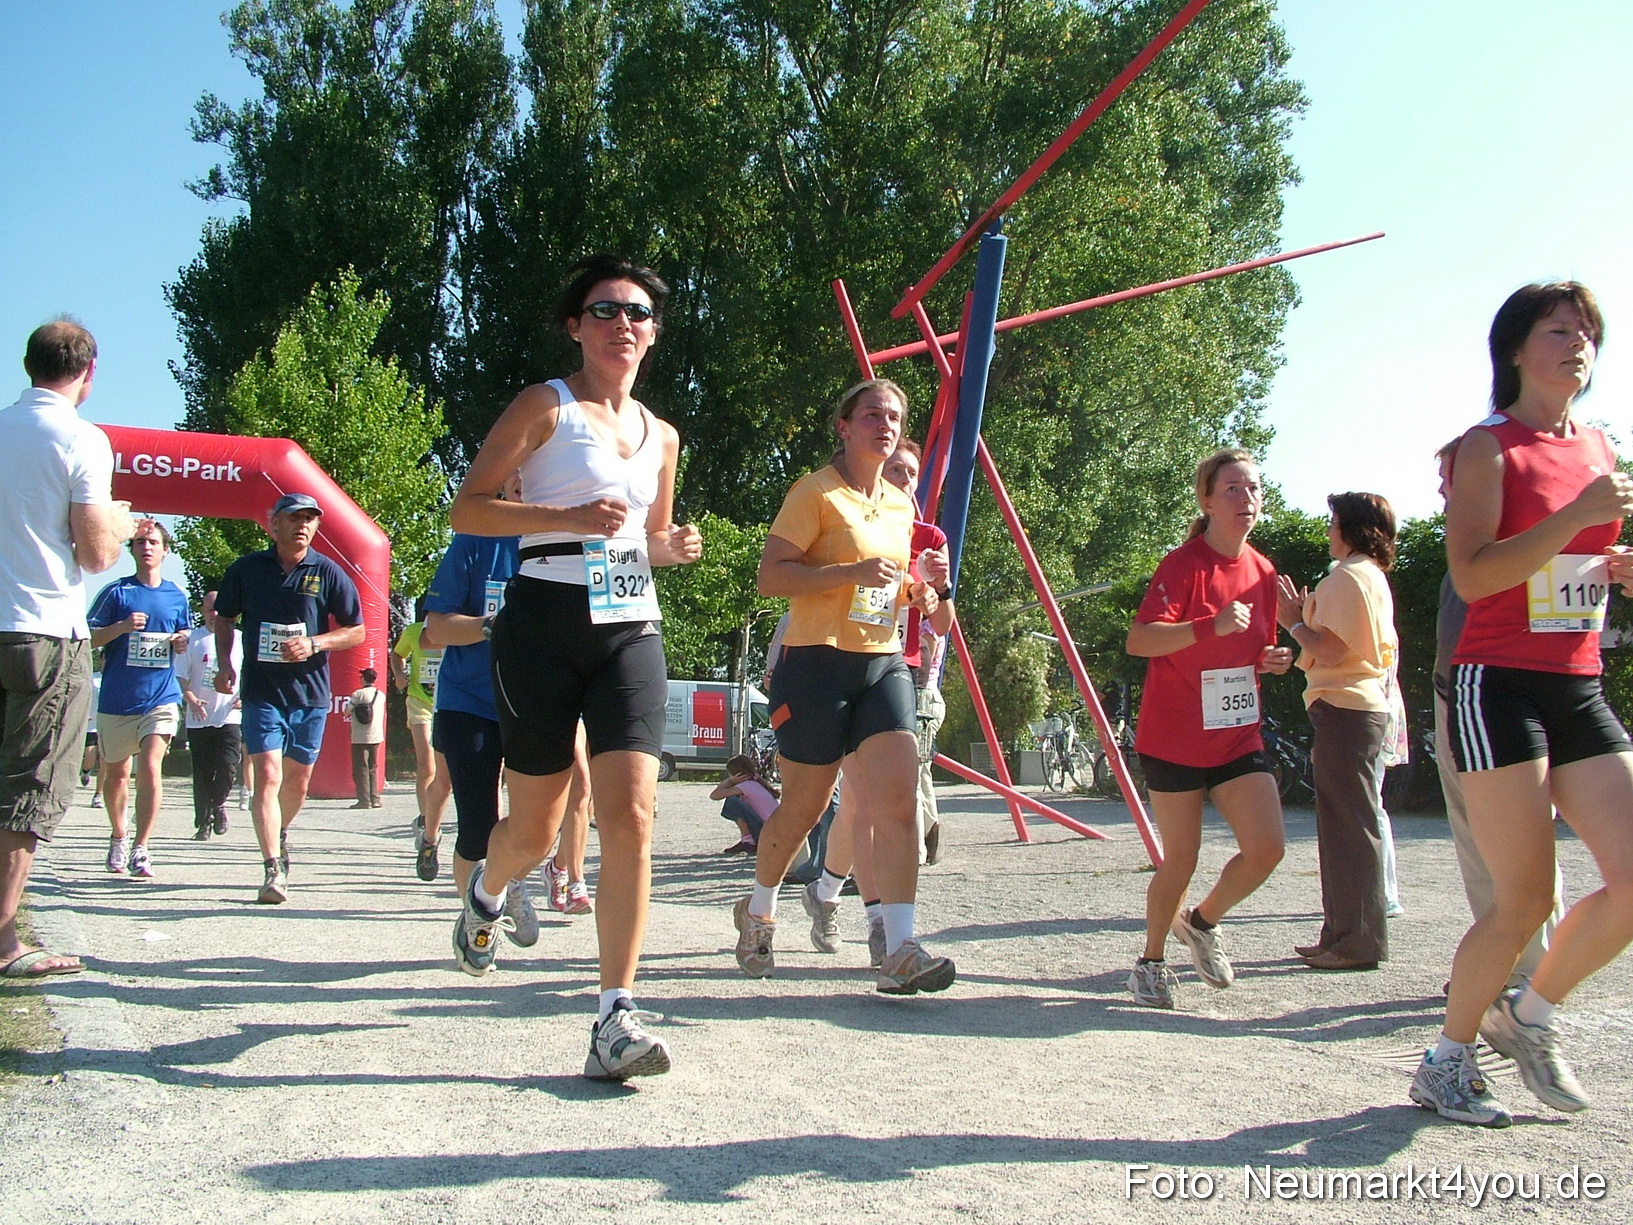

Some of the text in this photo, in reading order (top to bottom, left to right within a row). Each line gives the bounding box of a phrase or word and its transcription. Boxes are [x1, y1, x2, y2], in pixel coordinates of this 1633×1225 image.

[114, 453, 242, 482] LGS-Park
[608, 548, 638, 564] Sigrid
[592, 572, 603, 585] D
[488, 602, 496, 612] D
[870, 590, 889, 610] 592
[271, 627, 303, 638] Wolfgang
[139, 647, 168, 658] 2164
[1223, 675, 1247, 684] Martina
[1221, 692, 1255, 711] 3550
[692, 724, 723, 739] Braun
